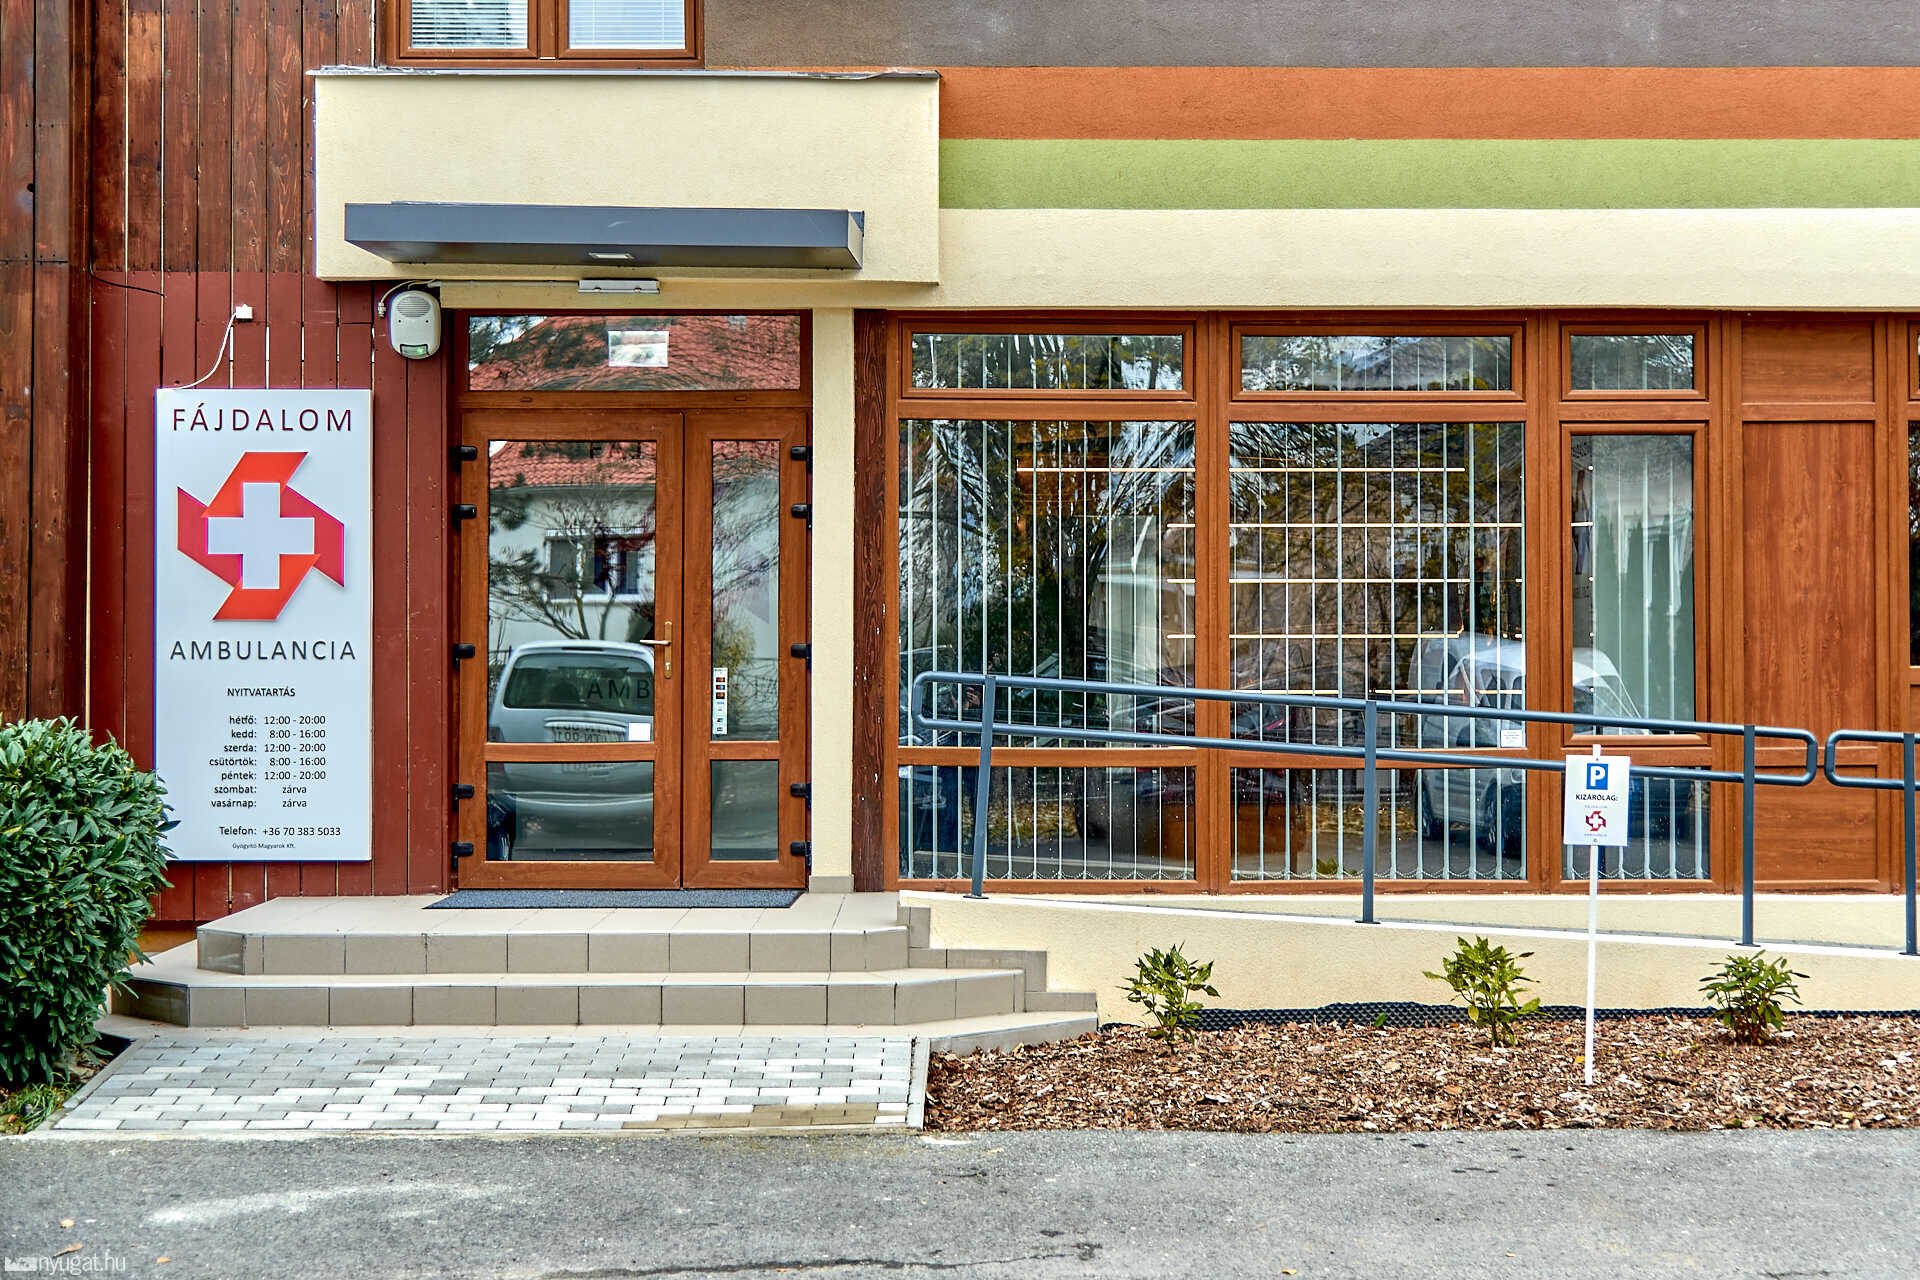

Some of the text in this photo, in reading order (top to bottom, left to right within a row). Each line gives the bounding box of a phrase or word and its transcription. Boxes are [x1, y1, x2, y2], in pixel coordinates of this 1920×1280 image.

[173, 402, 352, 432] FÁJDALOM
[170, 640, 356, 661] AMBULANCIA
[227, 686, 296, 697] NYITVATARTÁS
[229, 714, 257, 725] hétfő:
[264, 716, 291, 725] 12:00
[299, 716, 326, 725] 20:00
[231, 729, 257, 739] kedd:
[269, 730, 291, 739] 8:00
[299, 730, 326, 739] 16:00
[223, 743, 257, 753] szerda:
[264, 744, 291, 753] 12:00
[299, 744, 326, 753] 20:00
[209, 757, 257, 766] csütörtök:
[269, 757, 291, 766] 8:00
[299, 757, 326, 766] 16:00
[221, 771, 257, 781] péntek:
[264, 771, 291, 780] 12:00
[299, 771, 326, 780] 20:00
[1590, 765, 1606, 787] P
[214, 785, 307, 794] szombat: zárva
[211, 798, 307, 809] vasárnap: zárva
[219, 826, 341, 836] Telefon: +36 70 383 5033
